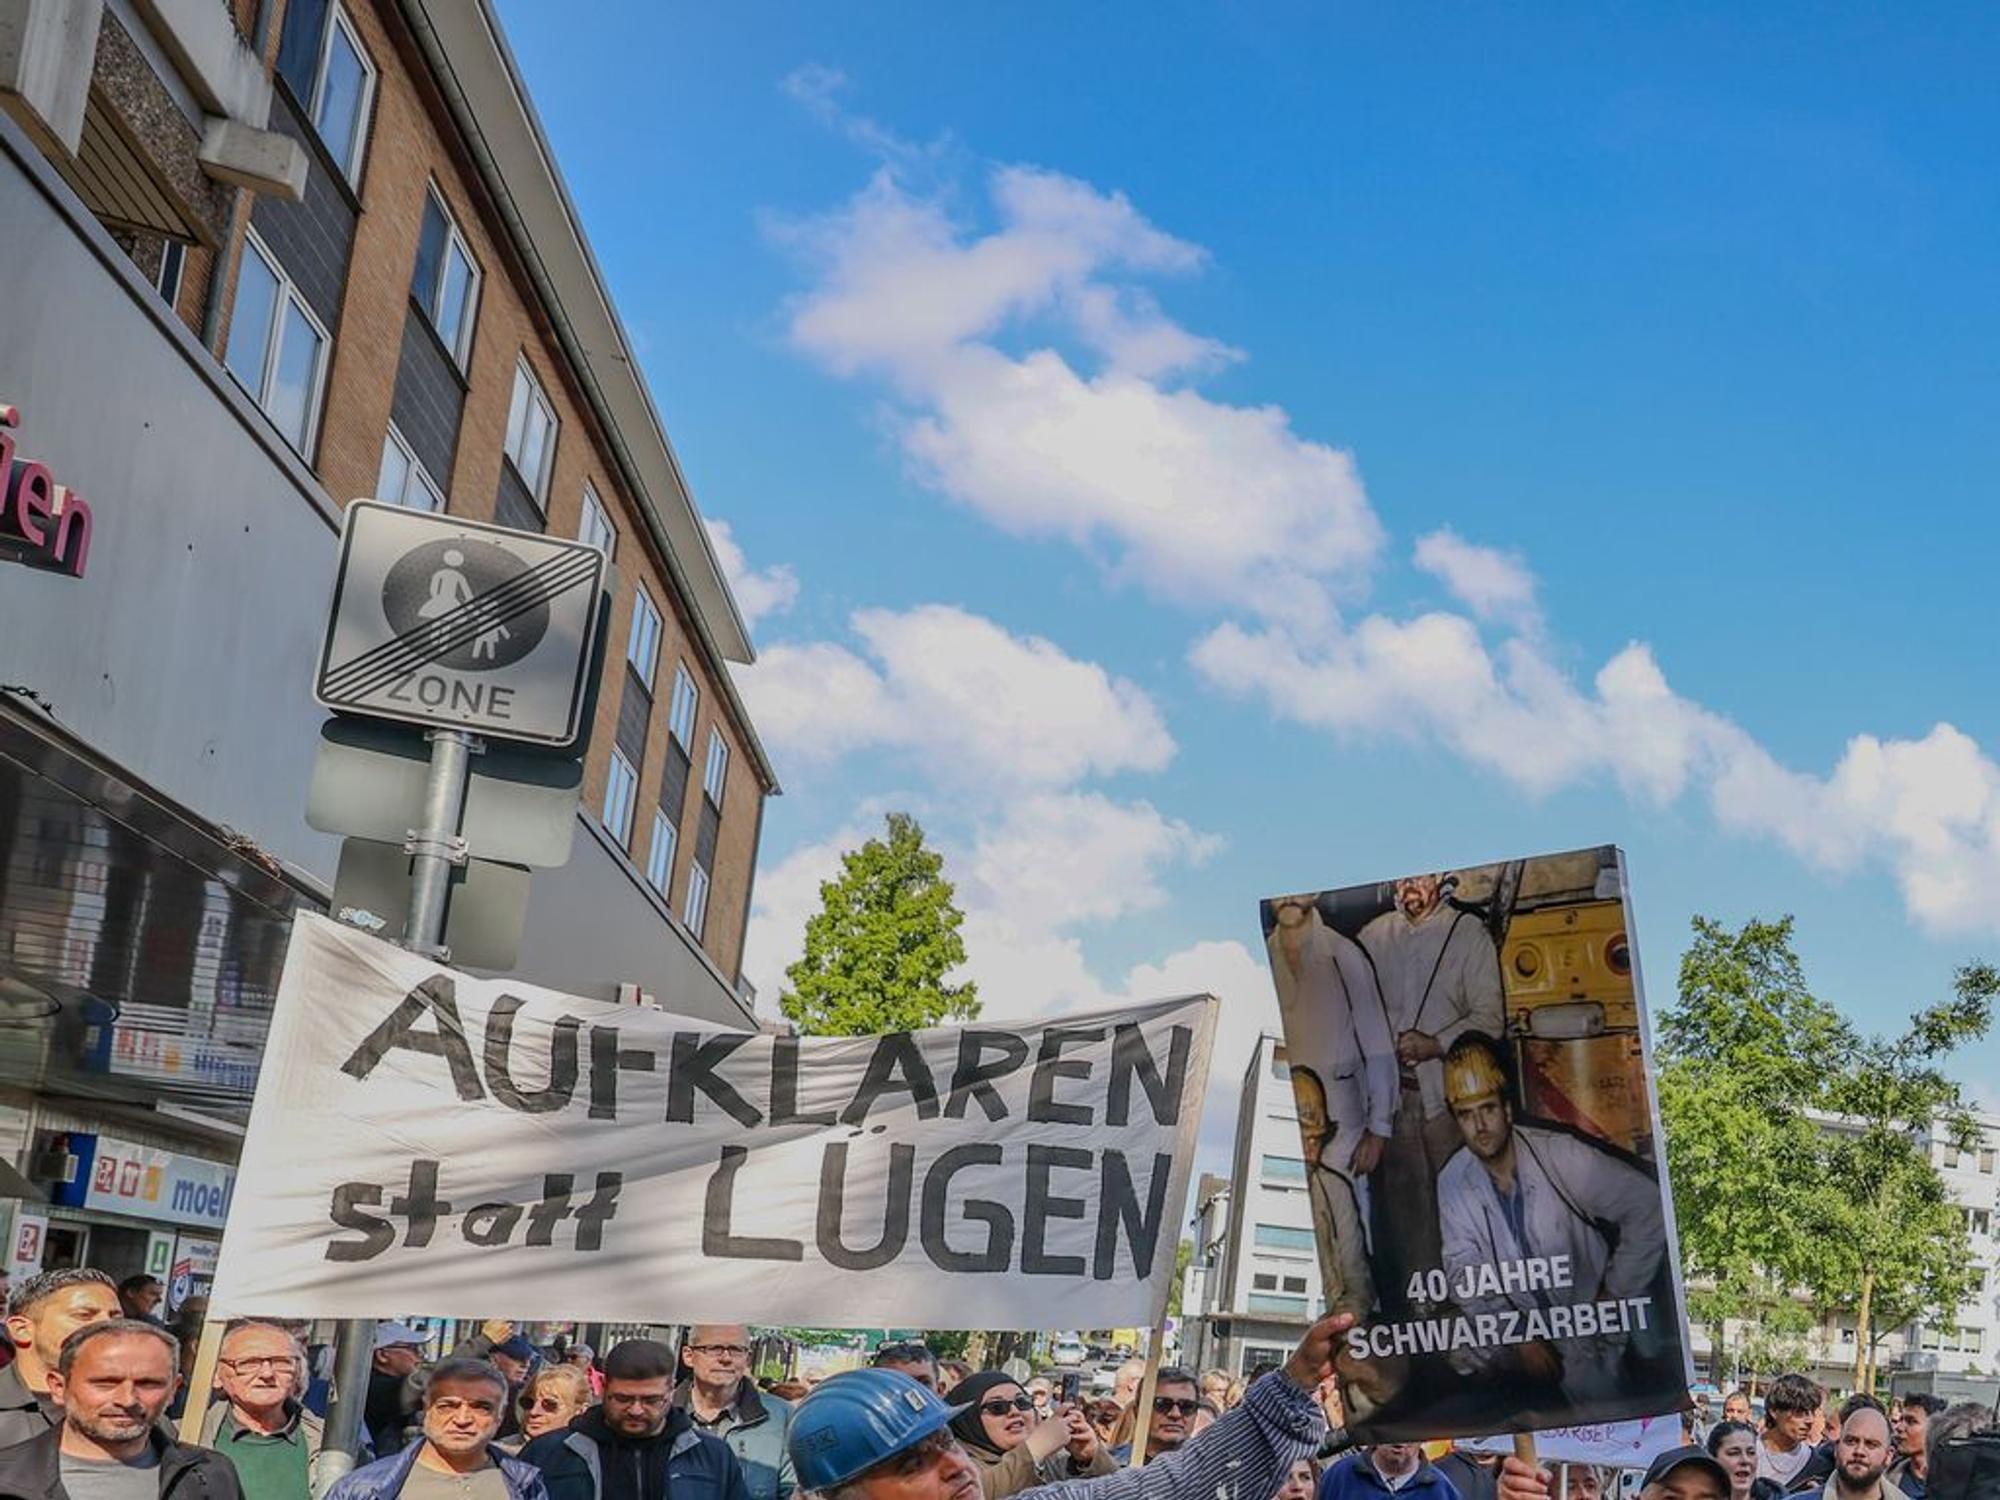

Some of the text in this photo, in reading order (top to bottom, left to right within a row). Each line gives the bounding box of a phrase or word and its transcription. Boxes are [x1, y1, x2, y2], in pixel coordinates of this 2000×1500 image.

[387, 671, 515, 719] ZONE
[325, 1124, 1171, 1280] statt LÜGEN
[1407, 1255, 1573, 1303] 40 JAHRE
[1347, 1297, 1652, 1360] SCHWARZARBEIT
